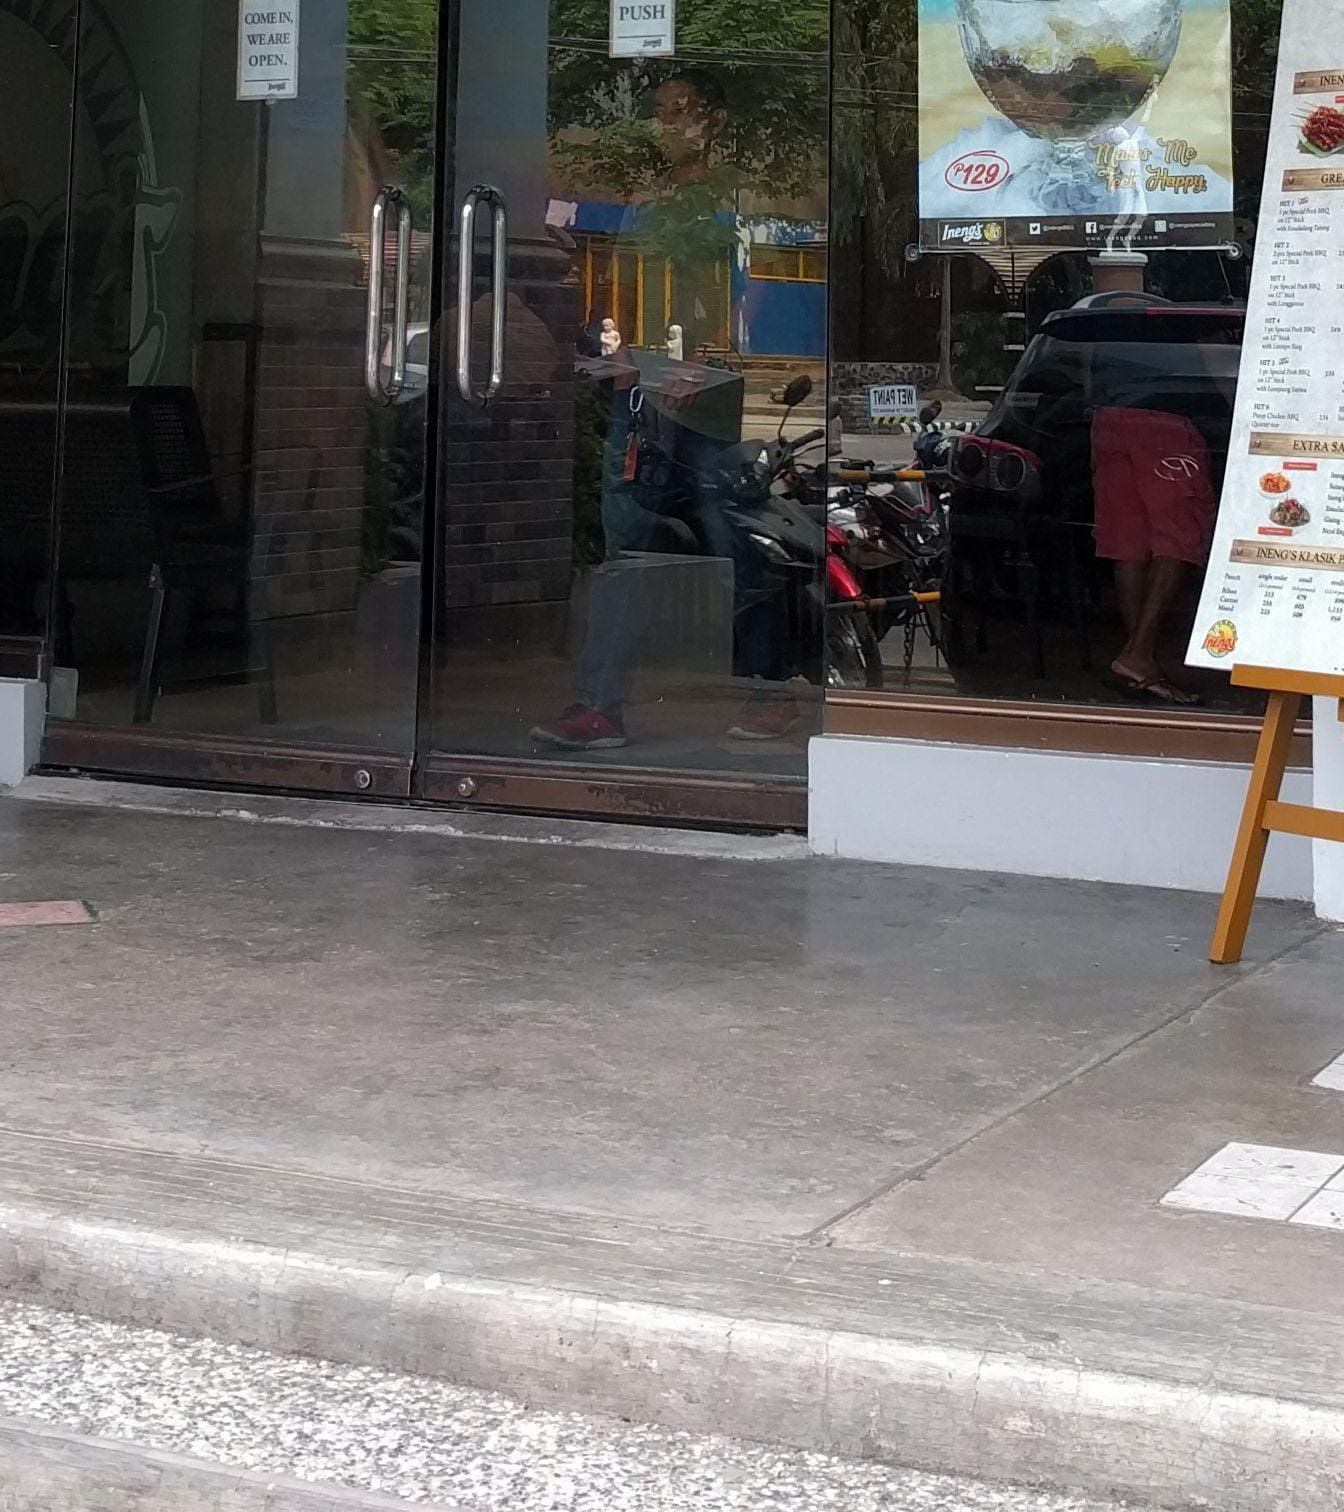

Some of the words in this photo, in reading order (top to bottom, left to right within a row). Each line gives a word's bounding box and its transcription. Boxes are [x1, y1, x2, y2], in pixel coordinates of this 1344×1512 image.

[245, 12, 276, 25] COME
[279, 11, 293, 23] IN,
[619, 4, 665, 21] PUSH
[246, 33, 266, 45] WE
[267, 33, 290, 45] ARE
[248, 54, 287, 66] OPEN.
[1157, 137, 1197, 167] Me
[942, 222, 984, 242] Ineng's
[1292, 440, 1329, 452] EXTRA
[1257, 547, 1298, 560] INENG'S
[1299, 551, 1337, 564] KLASIK
